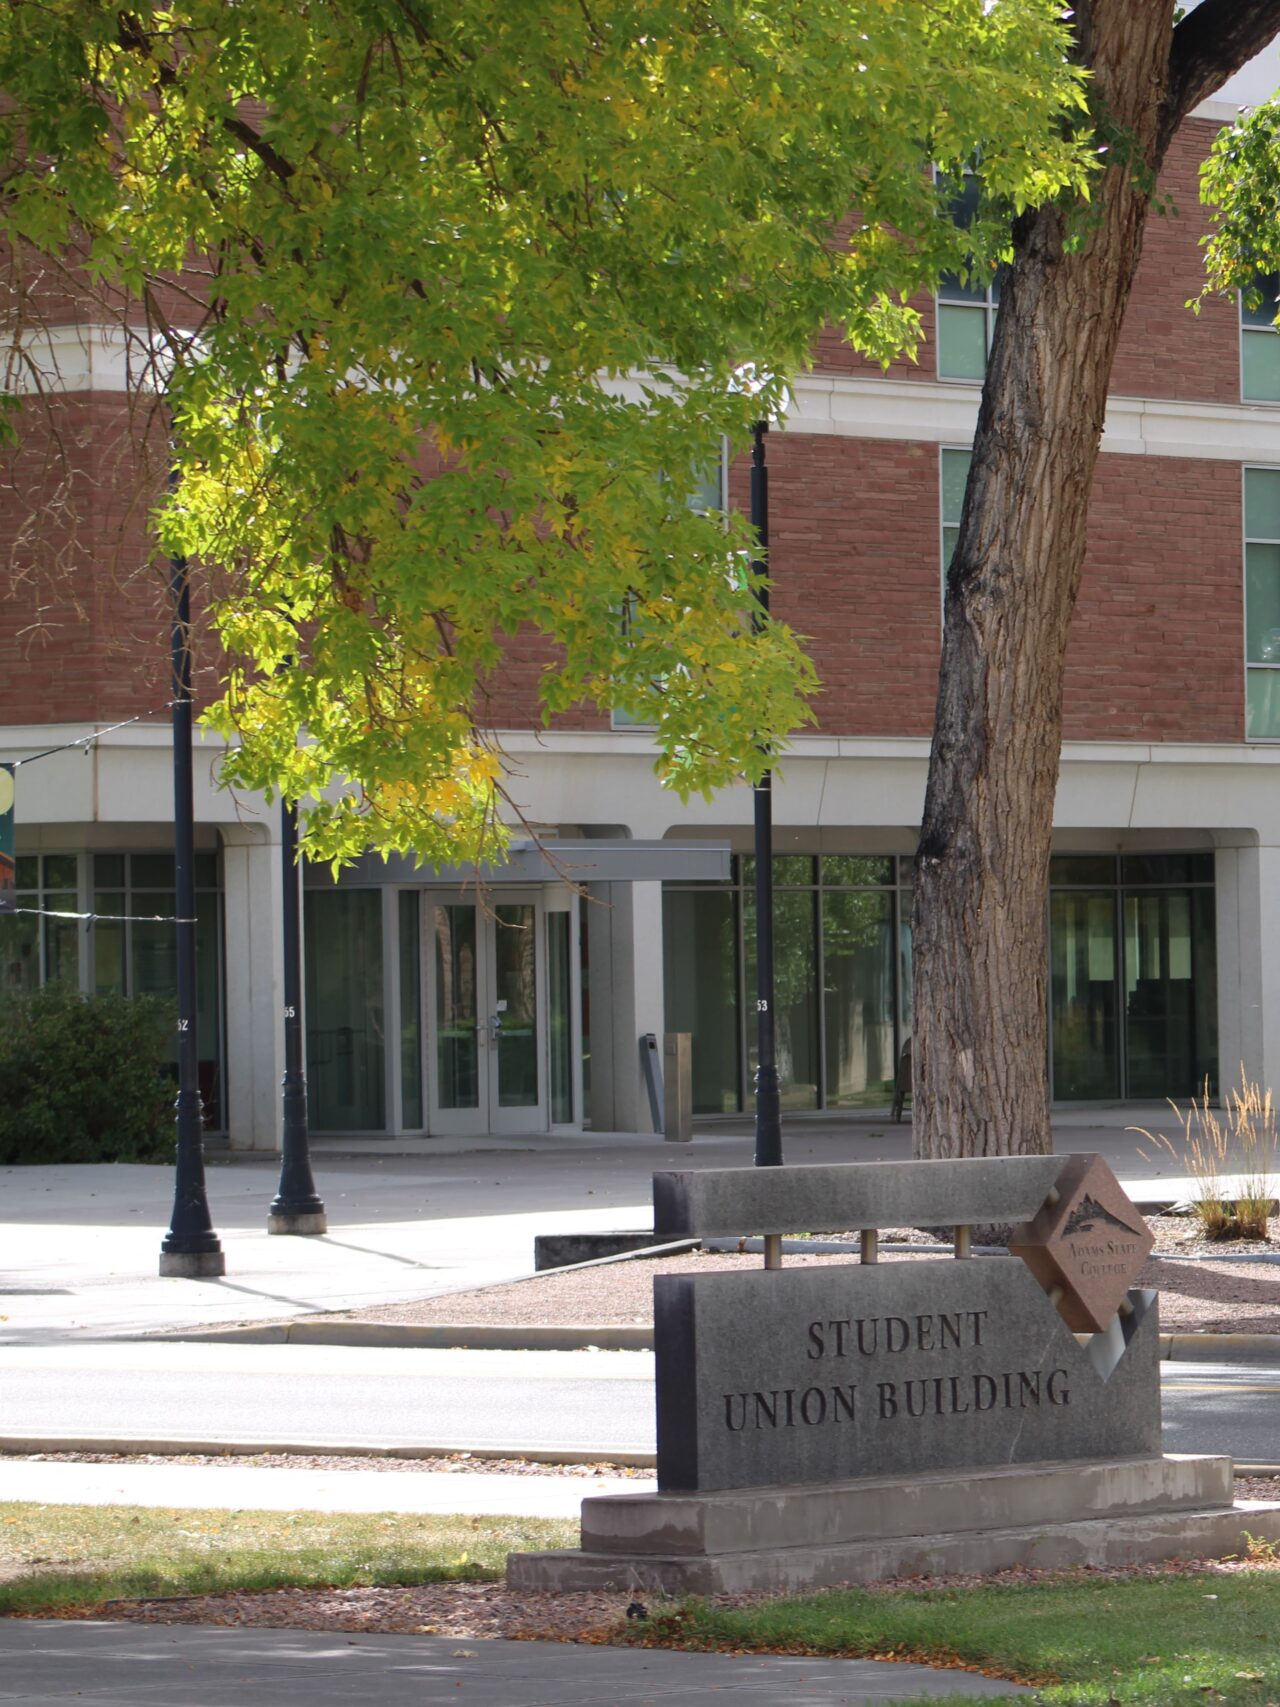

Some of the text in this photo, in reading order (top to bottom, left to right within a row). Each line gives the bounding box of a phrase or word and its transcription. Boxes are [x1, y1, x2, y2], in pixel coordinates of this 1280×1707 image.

[1069, 1240, 1137, 1257] ADAMS STATE
[1080, 1261, 1127, 1275] COLLEGE
[807, 1310, 988, 1360] STUDENT
[723, 1368, 1071, 1431] UNION BUILDING
